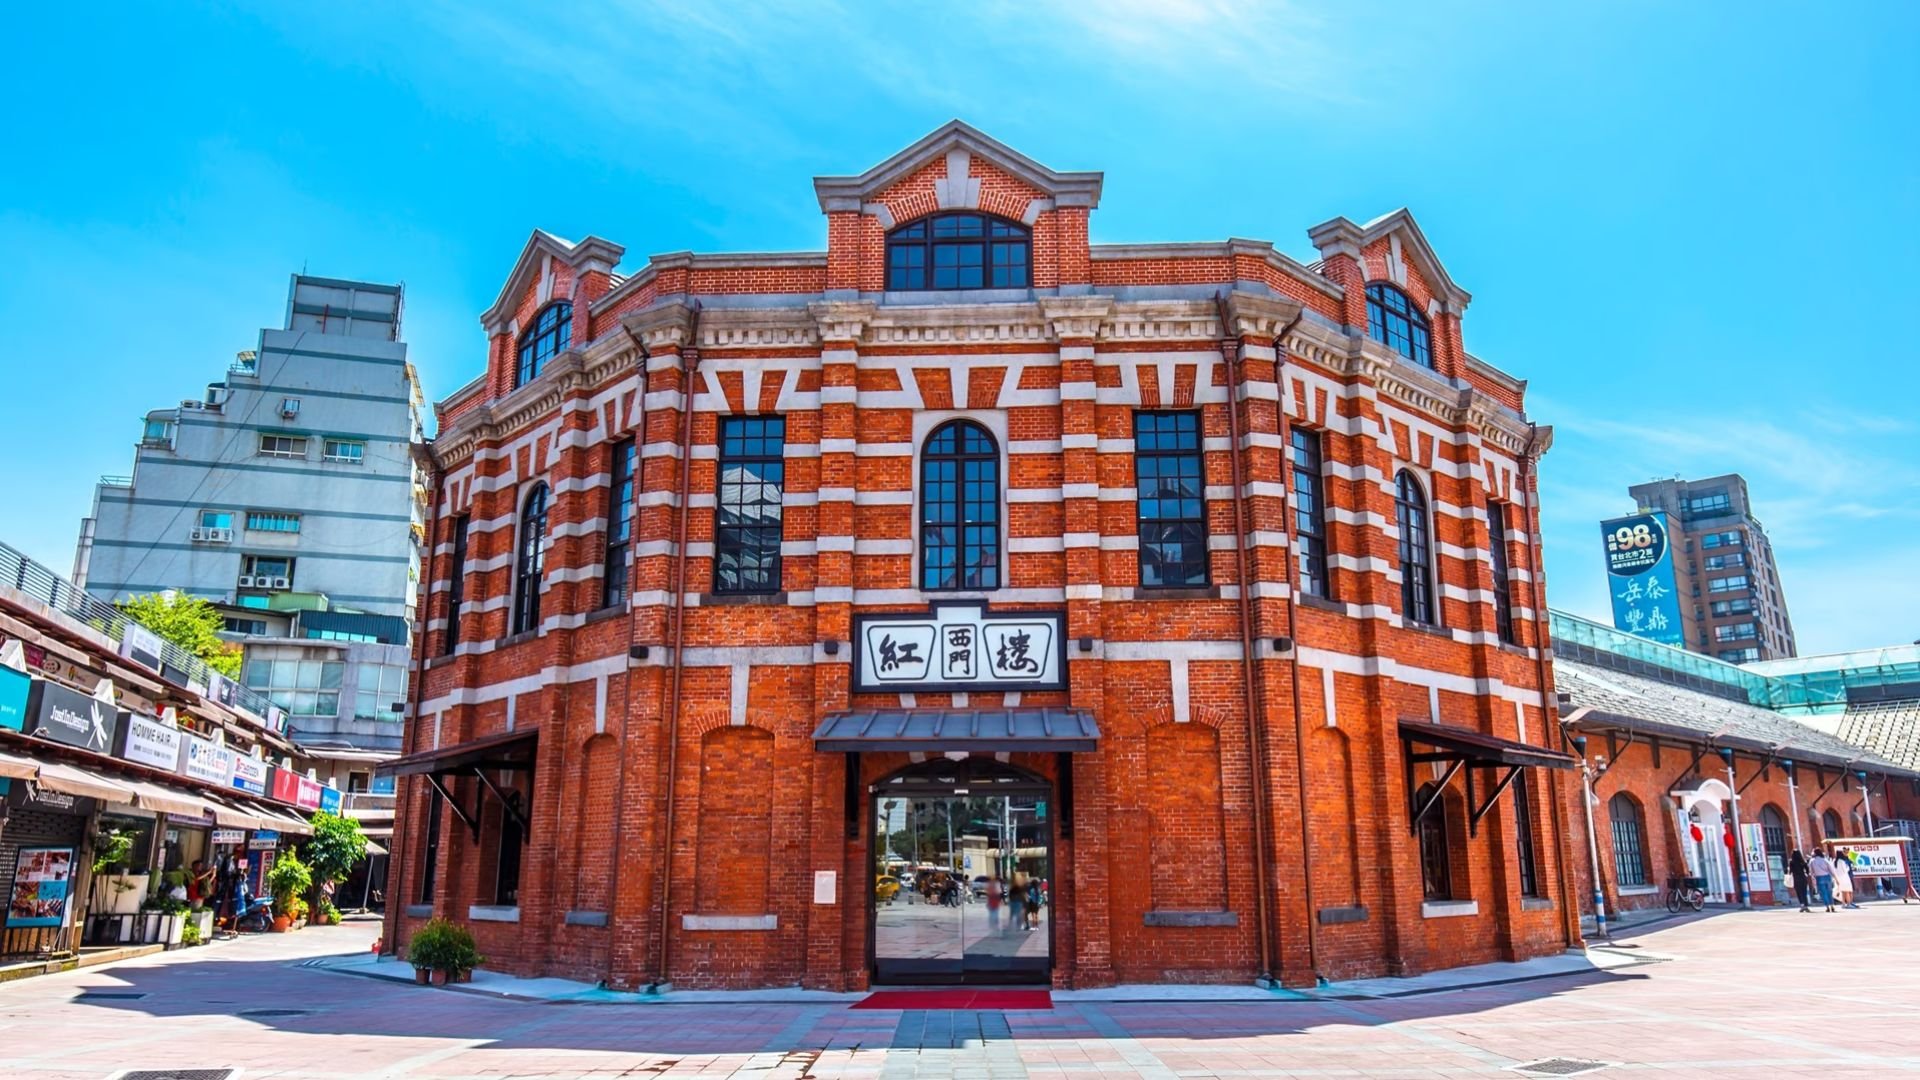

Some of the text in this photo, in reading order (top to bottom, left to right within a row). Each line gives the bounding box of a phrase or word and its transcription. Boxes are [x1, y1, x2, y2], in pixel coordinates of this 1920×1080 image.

[1616, 524, 1651, 550] 98
[132, 722, 171, 744] HOMME HAIR
[1747, 852, 1759, 862] 16
